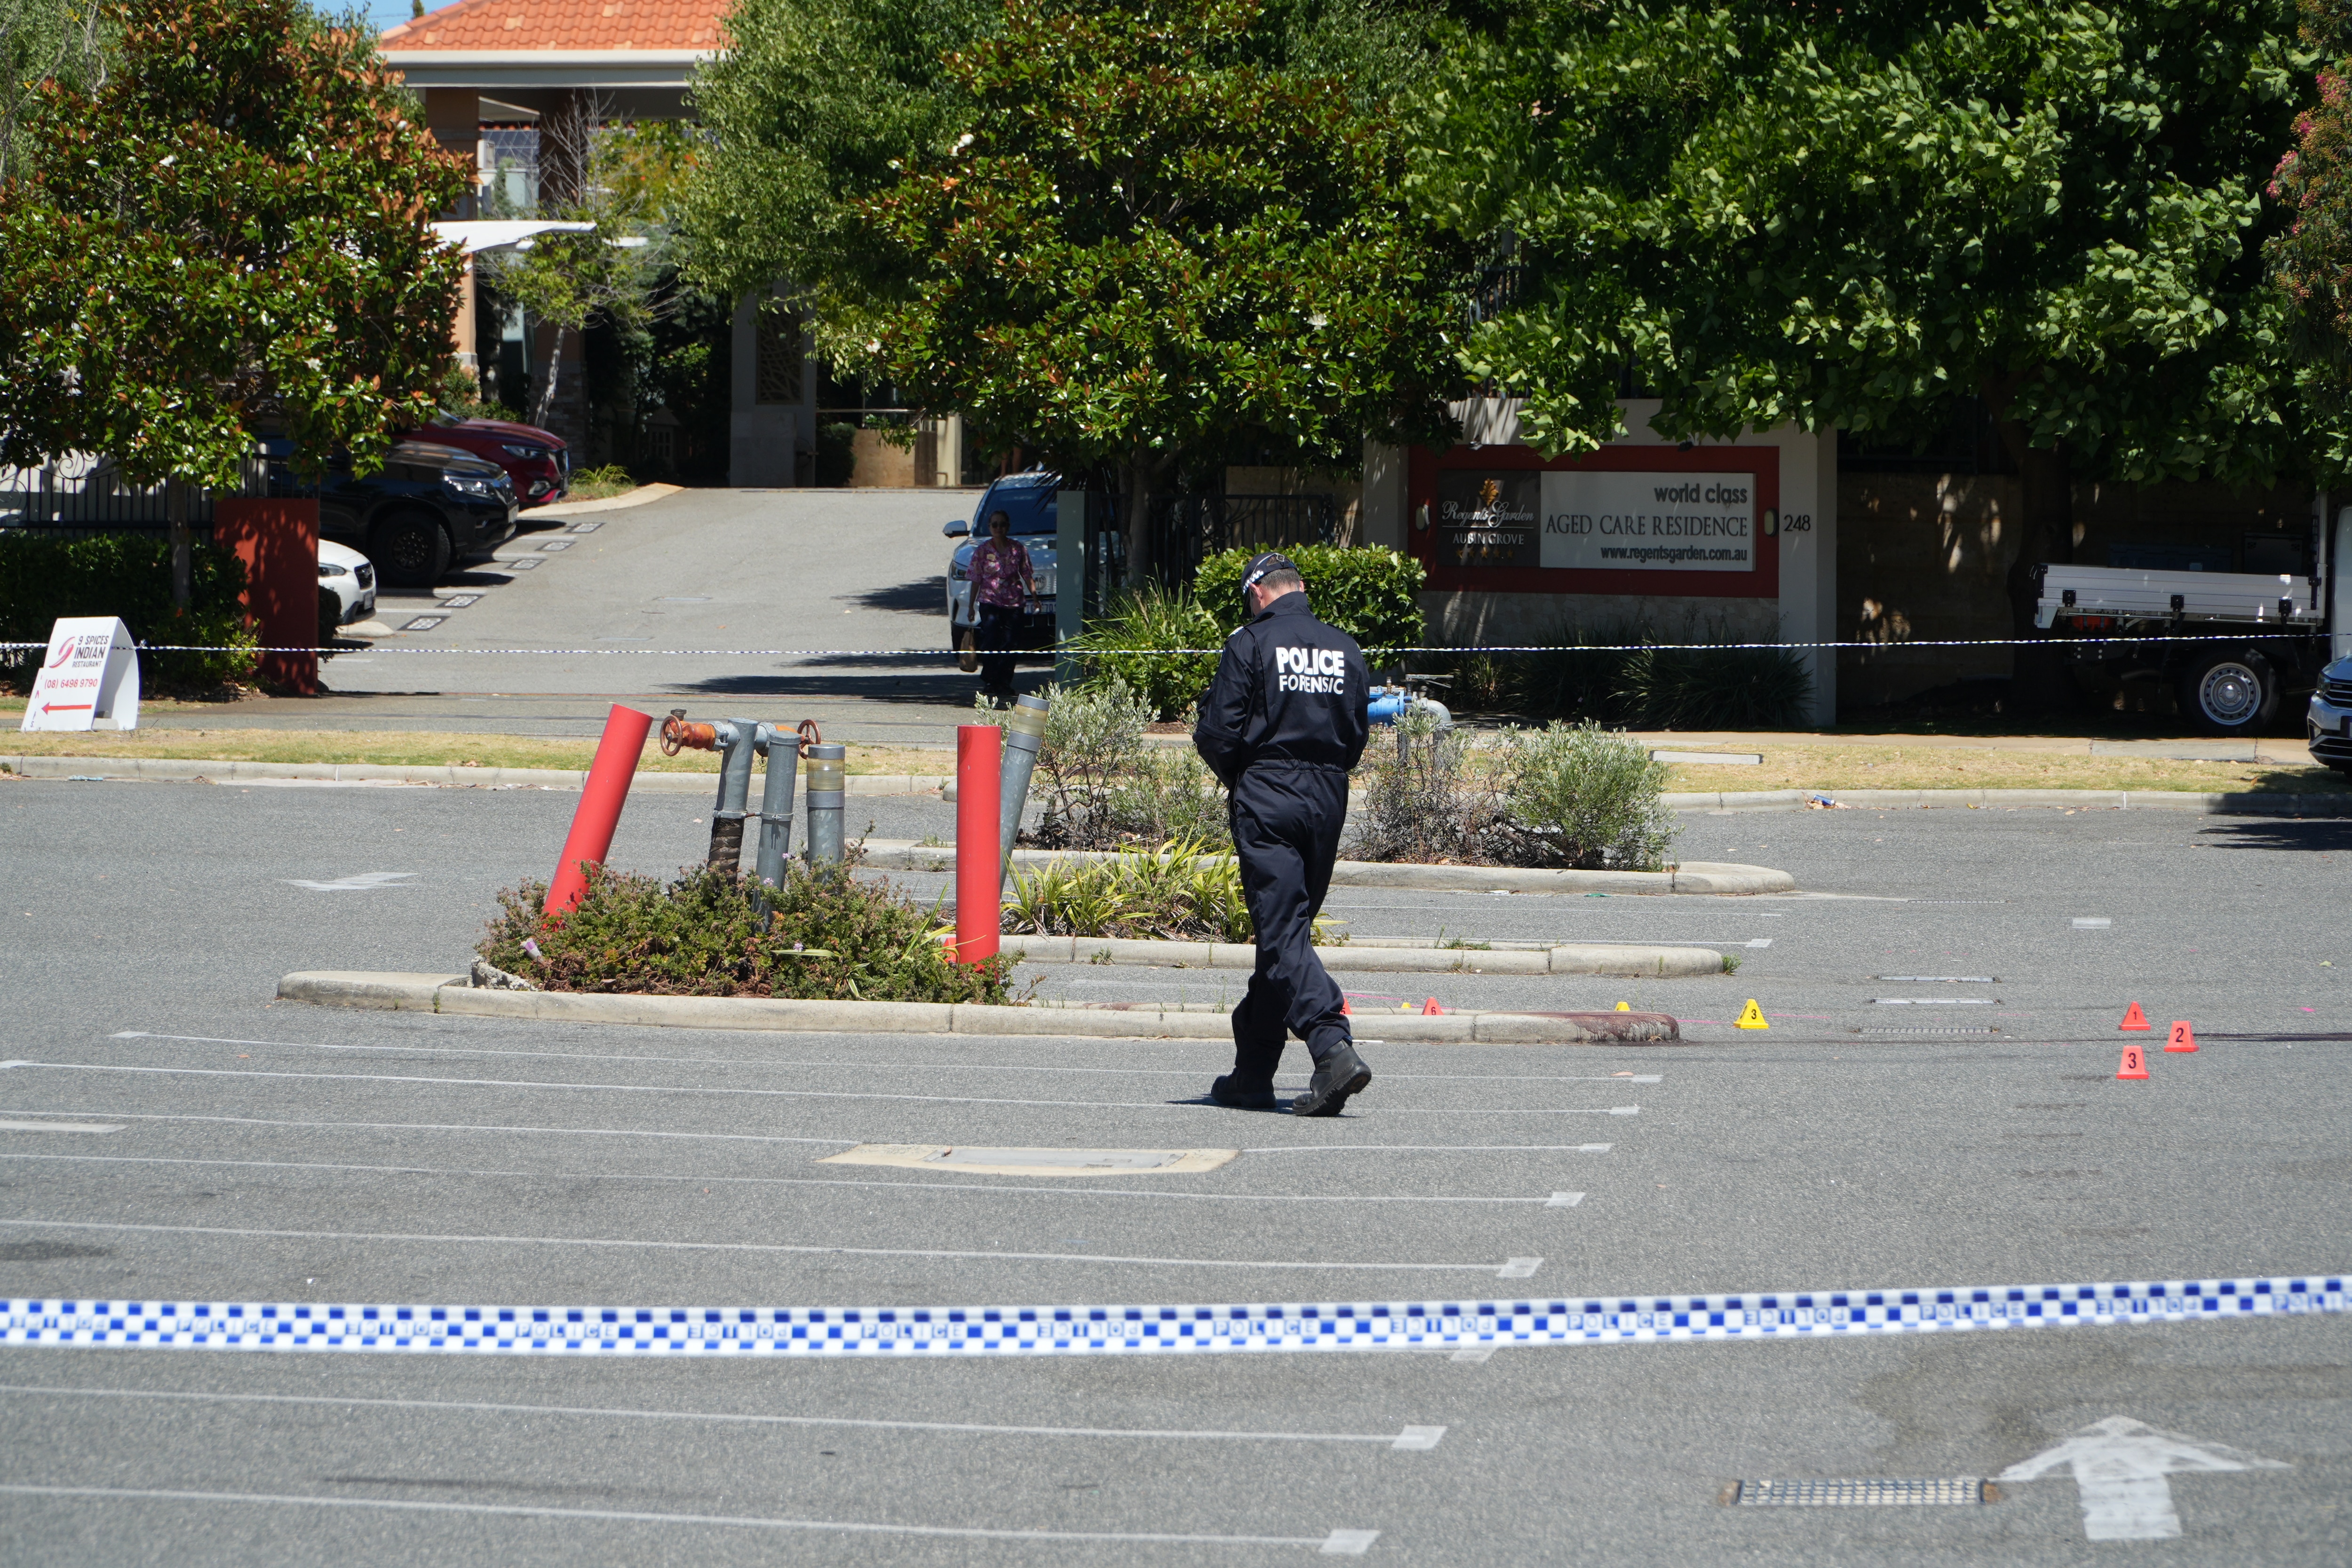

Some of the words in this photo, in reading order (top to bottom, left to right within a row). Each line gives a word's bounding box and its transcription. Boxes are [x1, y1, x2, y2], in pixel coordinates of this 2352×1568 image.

[1654, 483, 1700, 503] world
[1705, 483, 1748, 503] class
[1442, 500, 1489, 527] Regents
[1487, 500, 1534, 528] Garden
[1545, 514, 1592, 534] AGED
[1600, 515, 1645, 535] CARE
[1652, 516, 1748, 537] RESIDENCE
[1784, 515, 1811, 531] 248
[1453, 532, 1486, 545] AUBIN
[1488, 533, 1524, 545] GROVE
[1600, 545, 1748, 564] www.regentsgarden.com.au
[78, 636, 83, 645] 9
[85, 635, 109, 645] SPICES
[74, 646, 106, 659] INDIAN
[1276, 647, 1344, 677] POLICE
[45, 678, 58, 690] (08)
[61, 679, 78, 688] 6498
[80, 678, 98, 687] 9790
[1279, 675, 1344, 695] FORENSIC
[1431, 1006, 1436, 1015] 6
[1751, 1009, 1757, 1019] 3
[2133, 1011, 2137, 1020] 1
[2176, 1027, 2184, 1043] 2
[2128, 1052, 2137, 1068] 3
[177, 1319, 275, 1332] POLICE
[518, 1323, 615, 1337] POLICE
[864, 1323, 962, 1337] POLICE
[1215, 1320, 1316, 1335] POLICE
[1569, 1312, 1669, 1329] POLICE
[1922, 1302, 2021, 1319] POLICE
